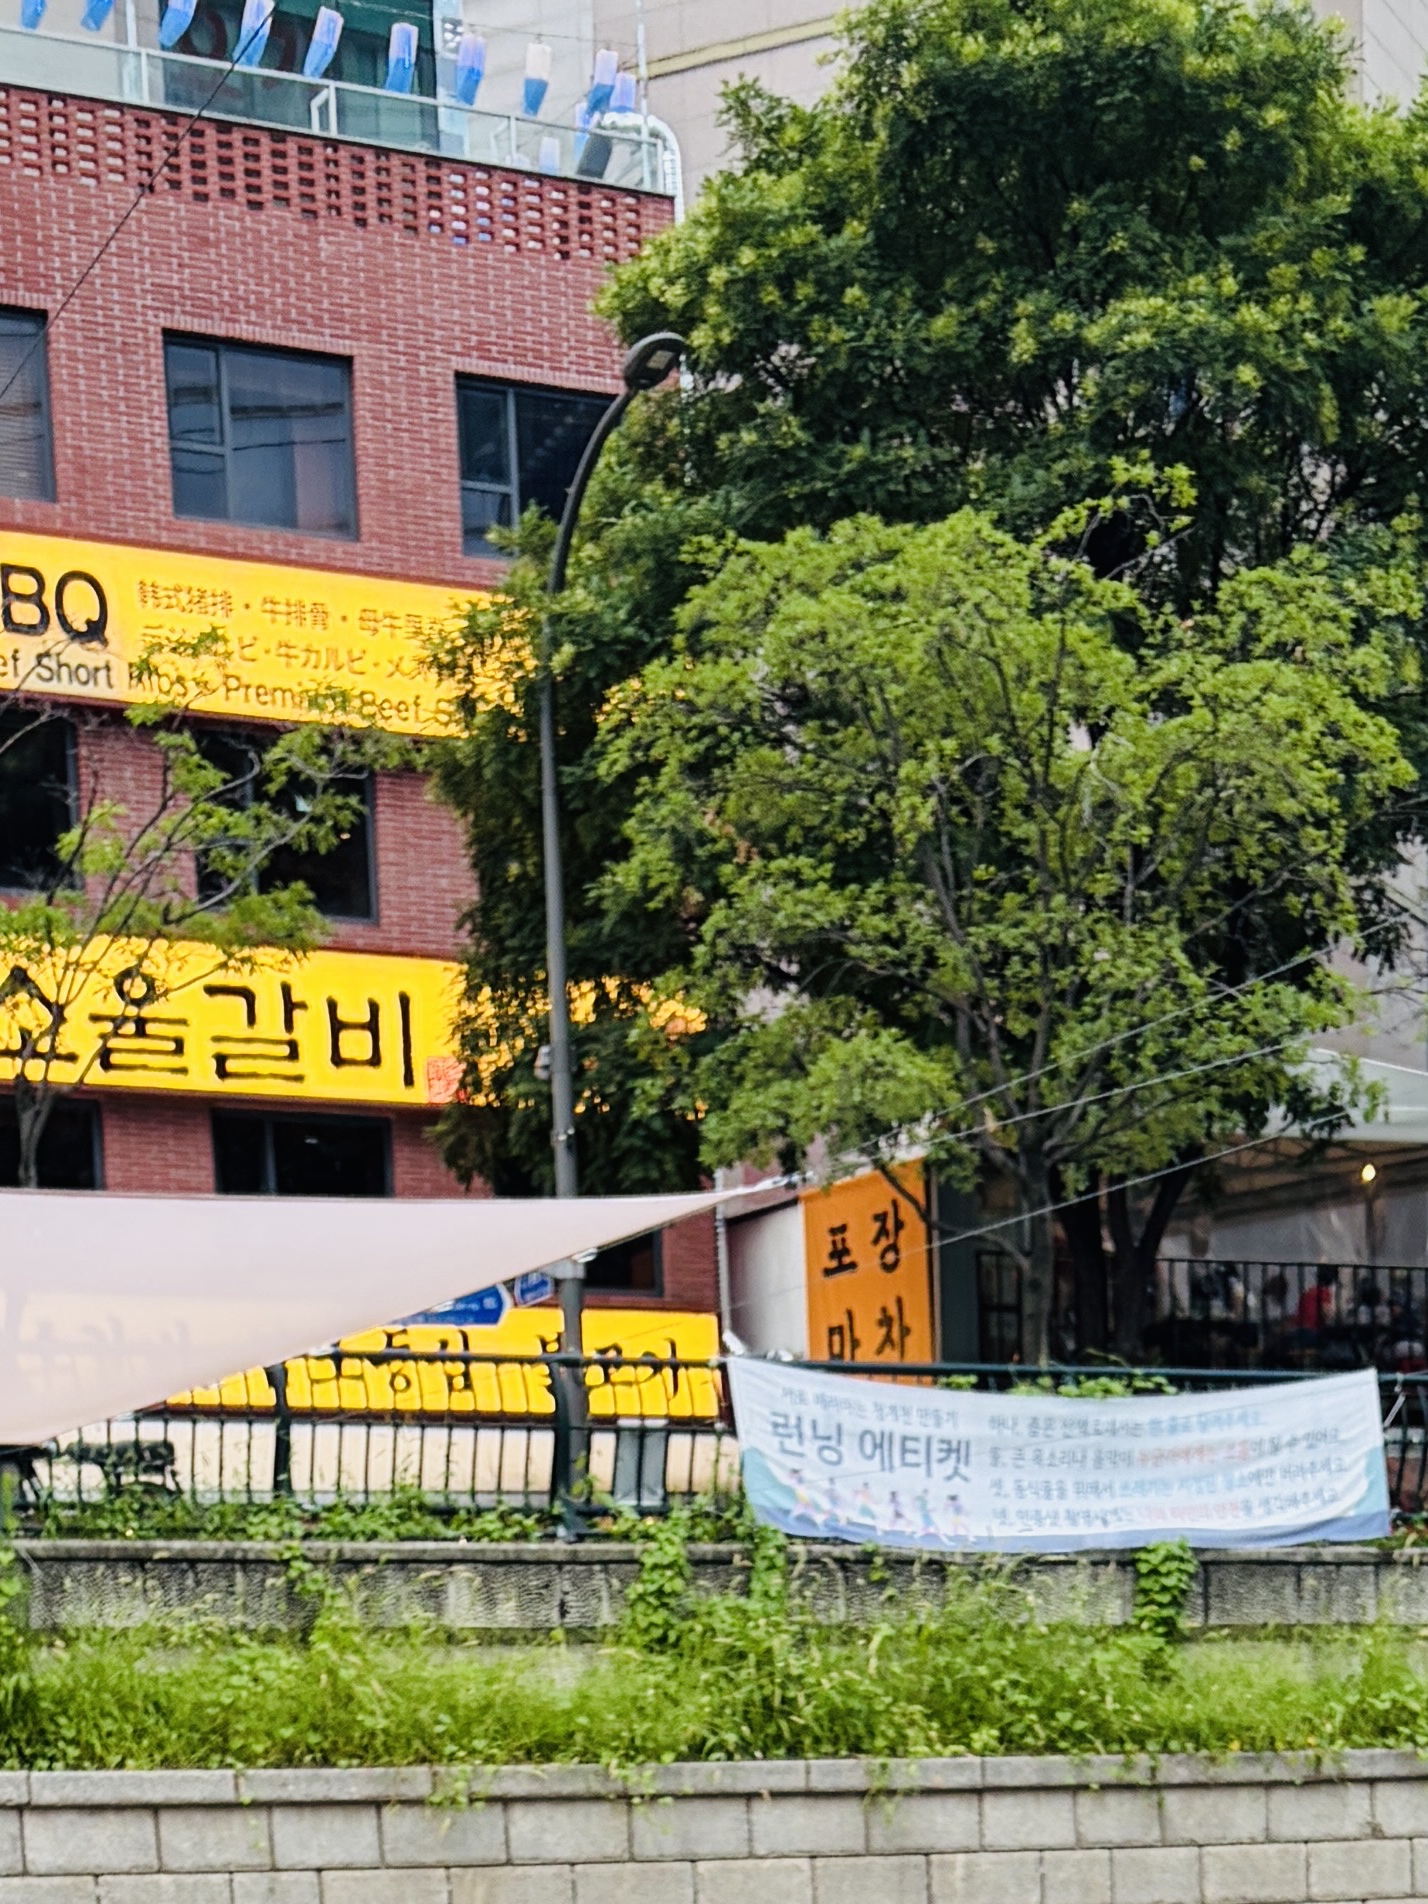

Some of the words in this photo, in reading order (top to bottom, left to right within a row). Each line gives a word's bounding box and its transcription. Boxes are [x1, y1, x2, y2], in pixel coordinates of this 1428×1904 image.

[35, 648, 114, 692] Short
[823, 1198, 905, 1278] 포장
[827, 1295, 912, 1362] 마차
[770, 1410, 845, 1467] 런닝
[857, 1428, 971, 1483] 에티켓
